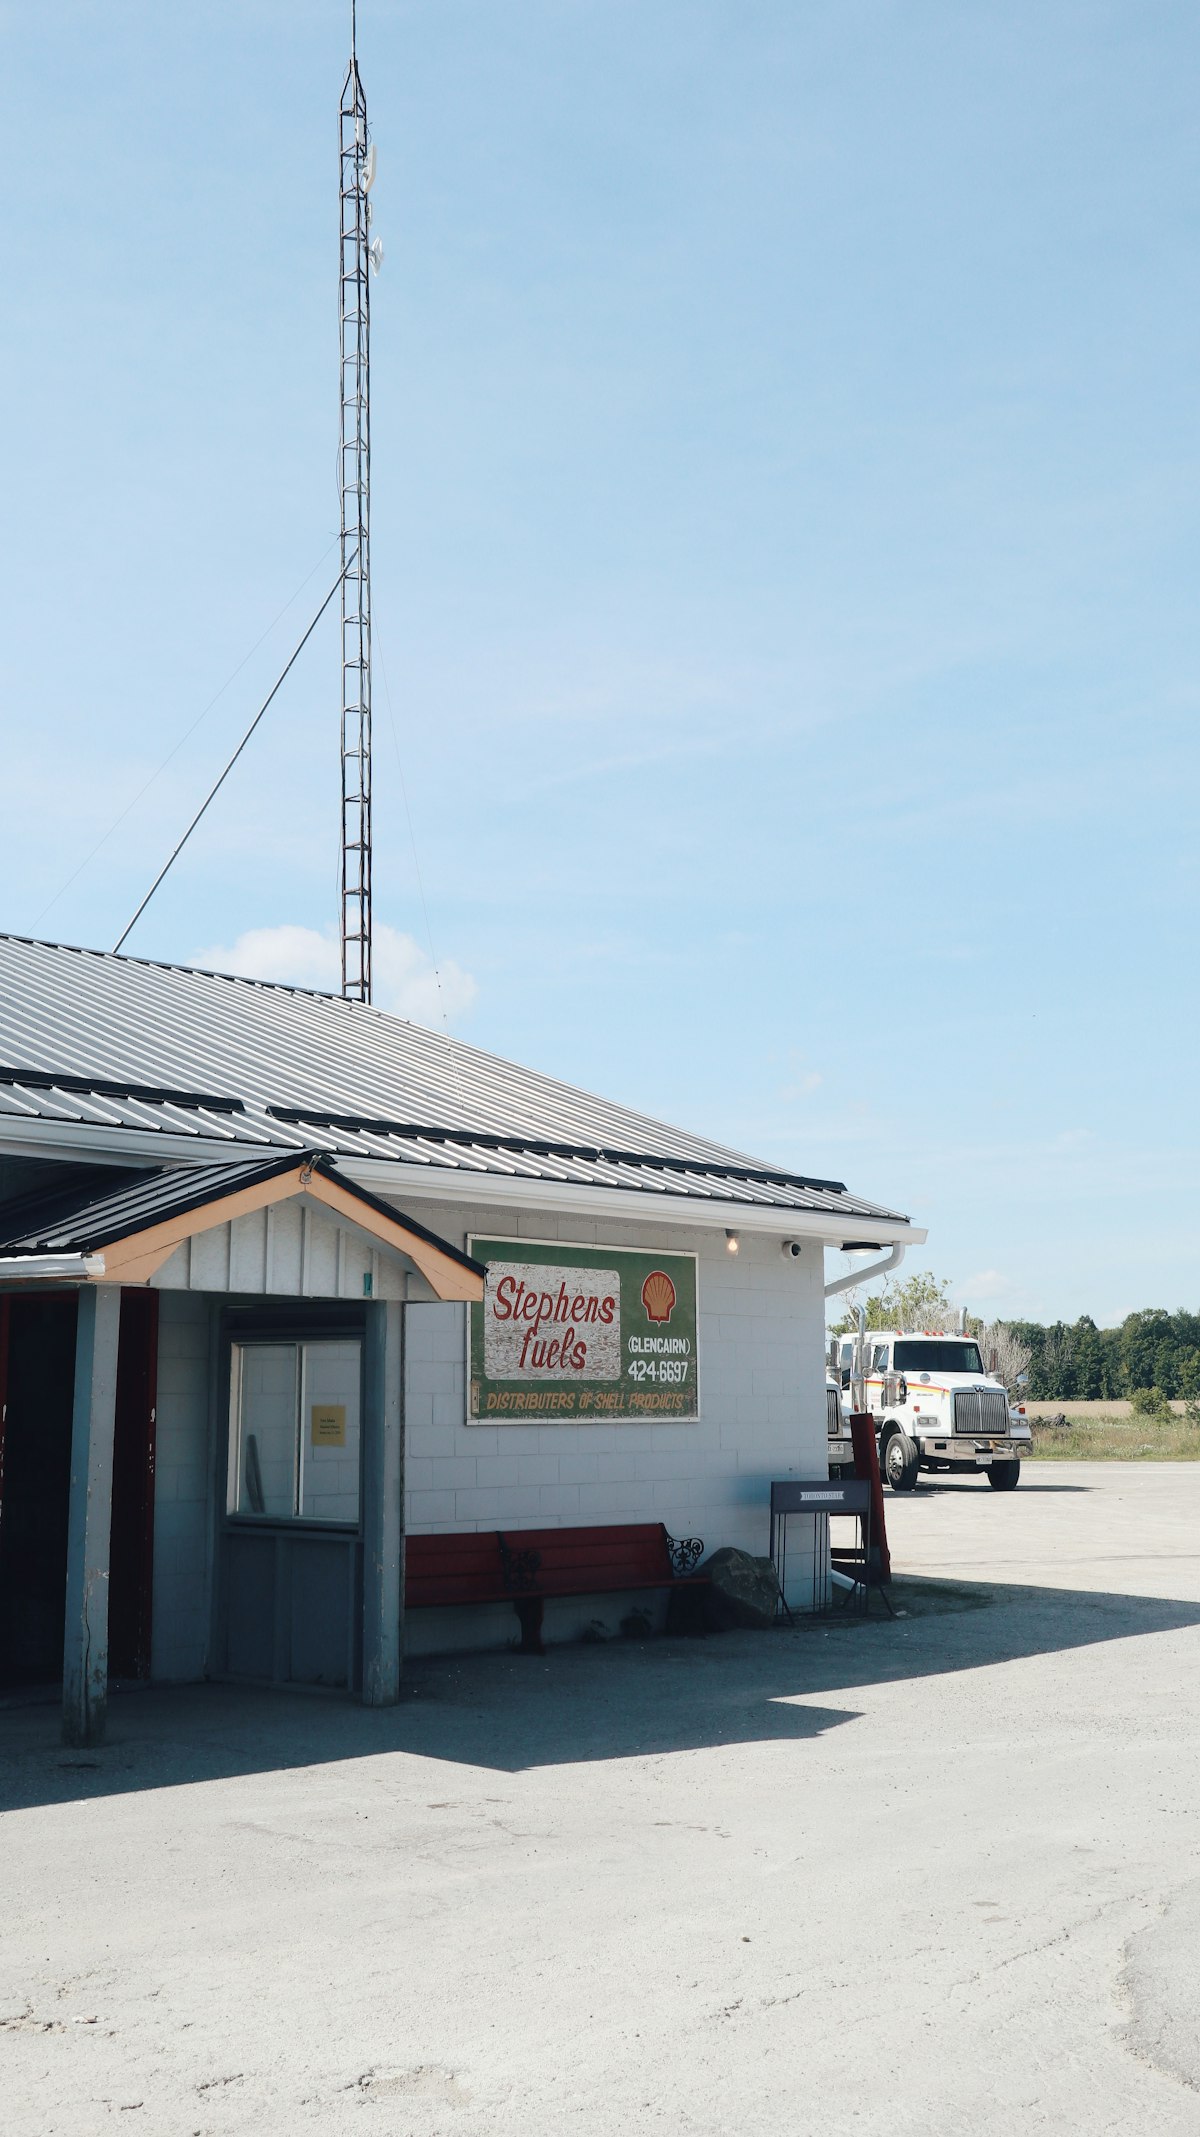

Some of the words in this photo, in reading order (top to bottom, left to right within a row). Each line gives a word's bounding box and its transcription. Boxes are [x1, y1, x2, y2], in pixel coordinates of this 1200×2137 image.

[493, 1276, 615, 1327] Stephens
[519, 1326, 587, 1370] fuels
[628, 1335, 690, 1355] (GLENCAIRN)
[487, 1391, 575, 1409] DISTRIBUTERS
[579, 1392, 593, 1409] OF
[594, 1392, 624, 1409] SHELL
